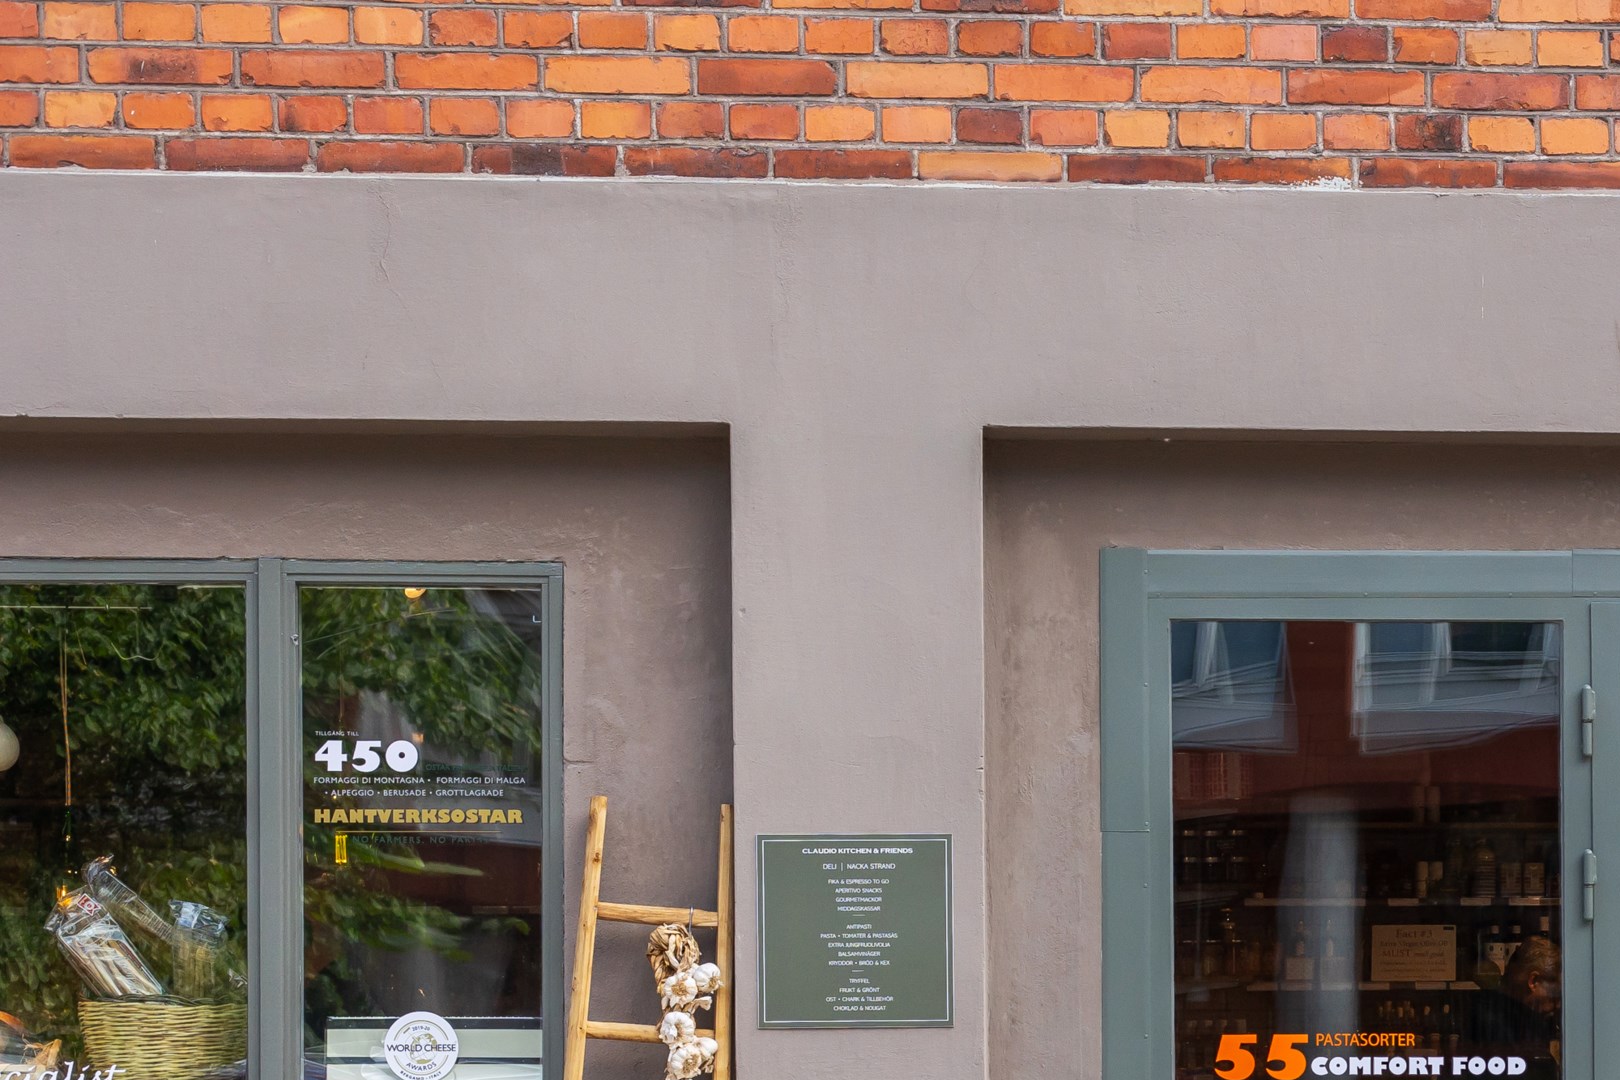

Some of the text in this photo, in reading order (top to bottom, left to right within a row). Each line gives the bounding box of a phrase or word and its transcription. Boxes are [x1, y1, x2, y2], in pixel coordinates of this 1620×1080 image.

[315, 740, 418, 772] 450
[314, 808, 523, 823] HANTVERKSOSTAR
[387, 1042, 456, 1052] WORLD CHEESE
[1316, 1033, 1415, 1047] PASTASORTER
[406, 1062, 437, 1072] AWARDS
[1311, 1056, 1526, 1076] COMFORT FOOD
